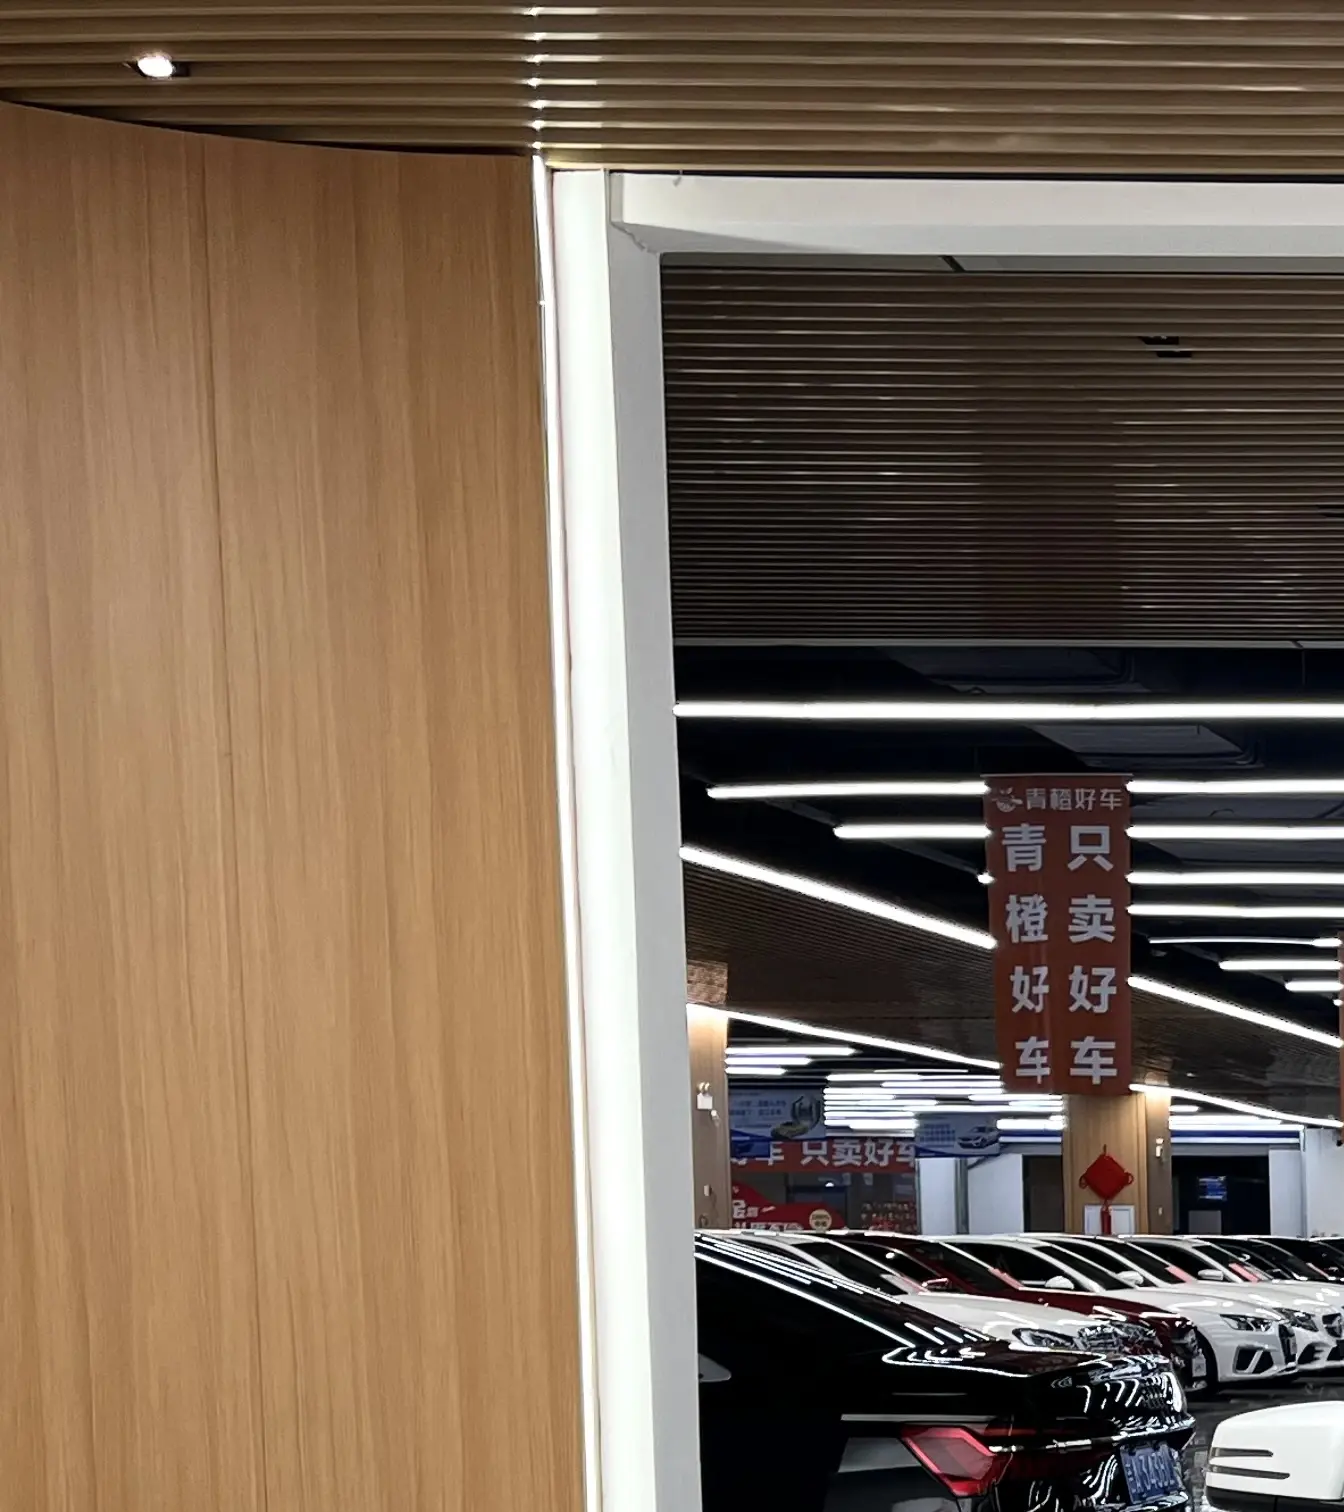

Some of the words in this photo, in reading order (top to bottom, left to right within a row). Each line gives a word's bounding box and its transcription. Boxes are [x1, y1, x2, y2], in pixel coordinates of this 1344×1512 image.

[1025, 788, 1123, 810] 青橙好车
[1001, 823, 1051, 1085] 青橙好车
[1066, 825, 1118, 1085] 只卖好车
